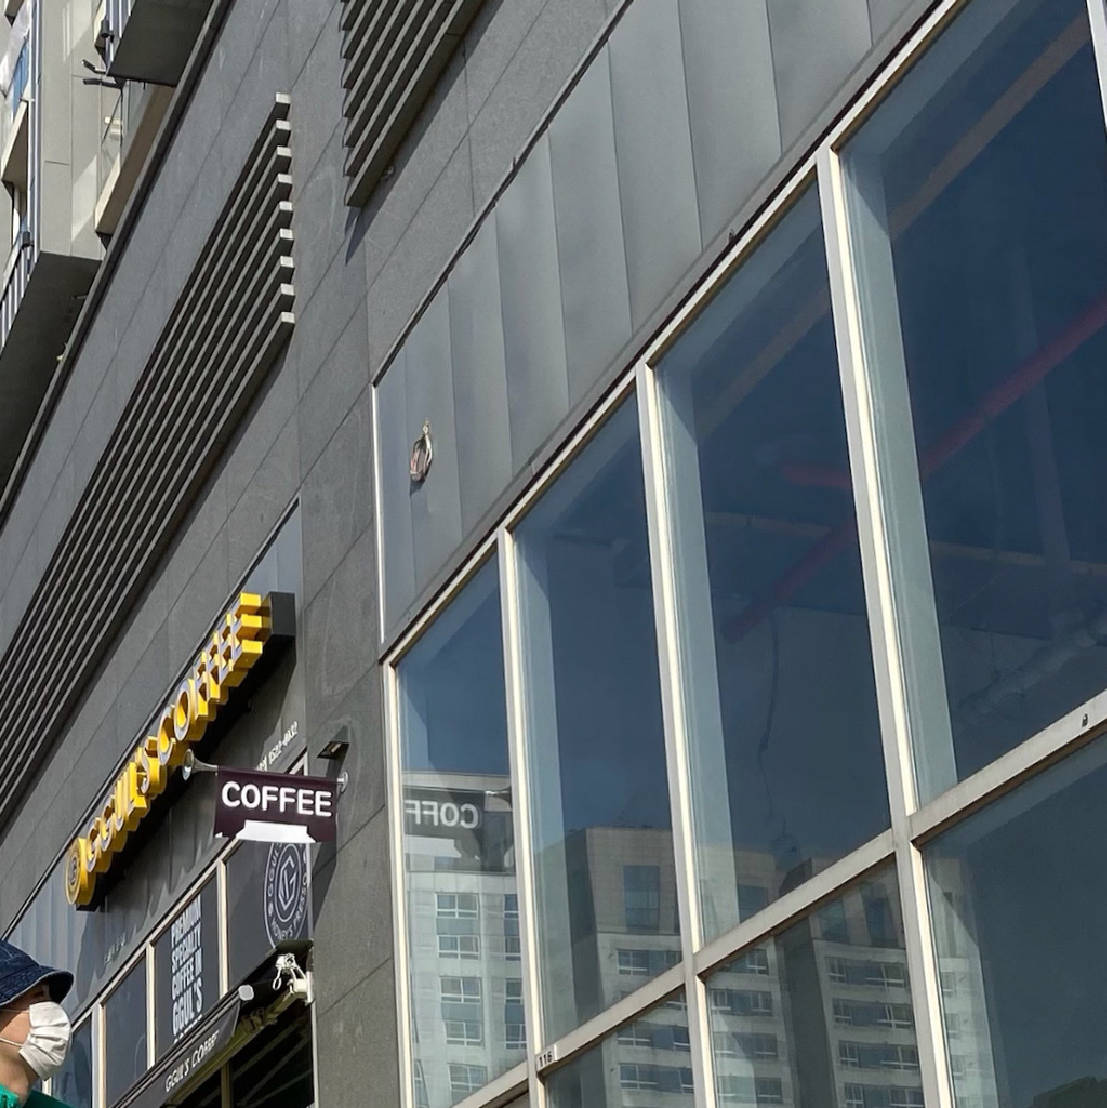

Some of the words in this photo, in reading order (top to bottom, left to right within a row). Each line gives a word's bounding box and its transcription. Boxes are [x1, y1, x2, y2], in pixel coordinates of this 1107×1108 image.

[157, 593, 263, 766] COFFEE
[221, 780, 333, 818] COFFEE
[171, 956, 195, 1001] COFFEE
[172, 975, 203, 1037] GGUL'S
[539, 1051, 553, 1067] 116
